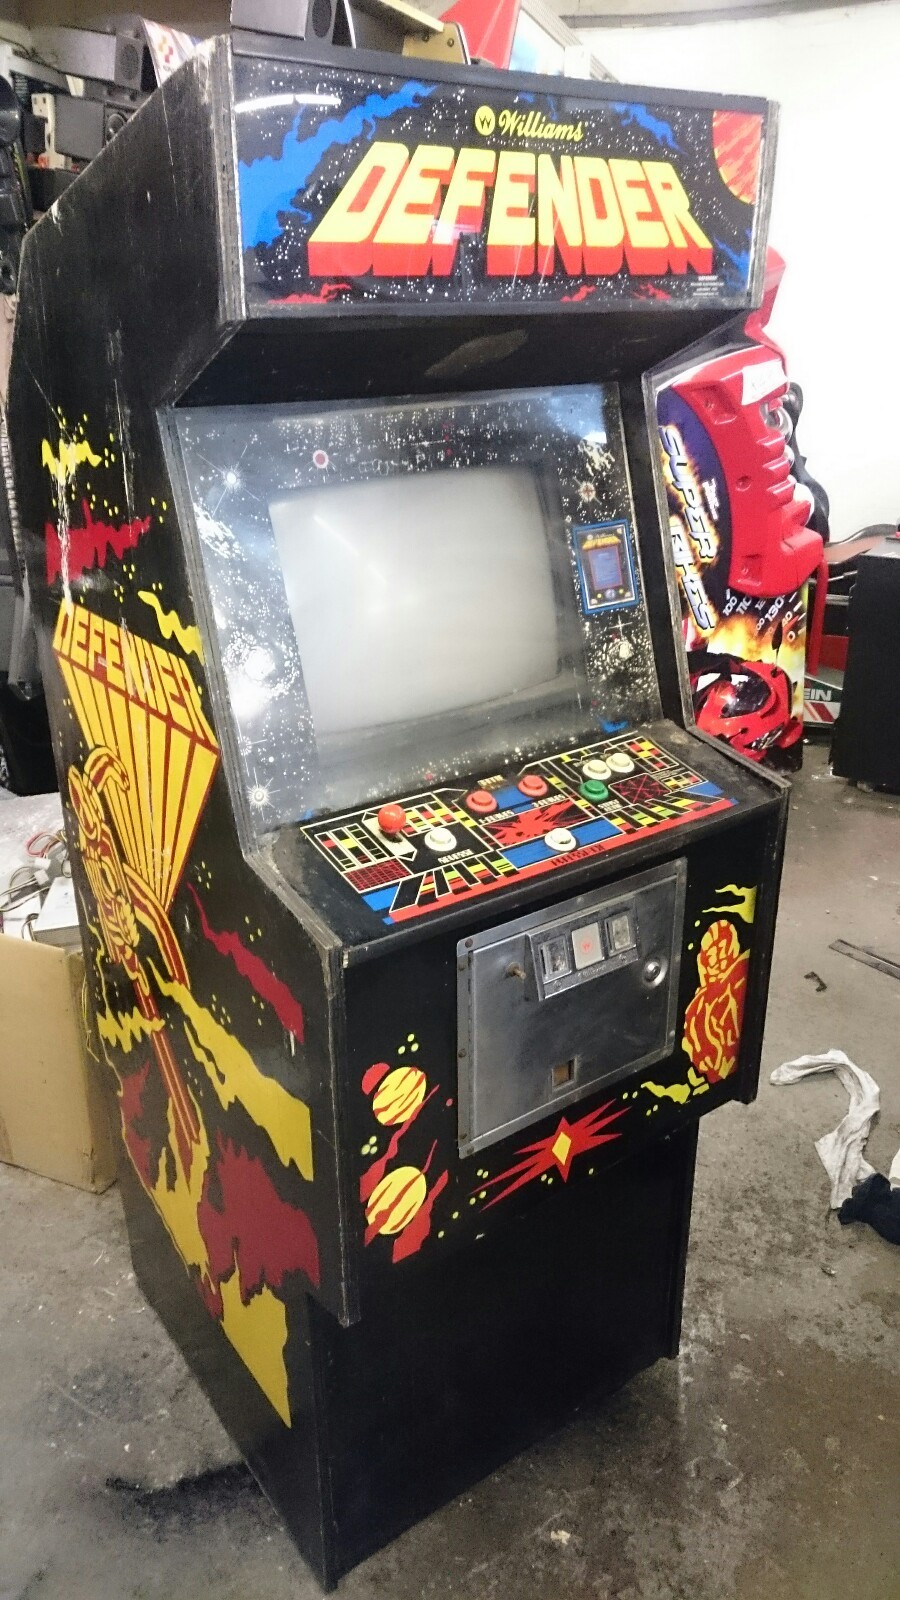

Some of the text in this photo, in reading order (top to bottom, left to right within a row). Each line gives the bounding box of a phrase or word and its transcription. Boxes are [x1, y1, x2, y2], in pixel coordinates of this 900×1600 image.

[498, 109, 583, 142] Williams
[307, 141, 714, 278] DEFENDER
[659, 424, 718, 559] SUPER
[669, 525, 716, 631] BIKES
[722, 596, 738, 616] 100
[764, 596, 785, 622] 130
[52, 597, 219, 748] DEFENDER
